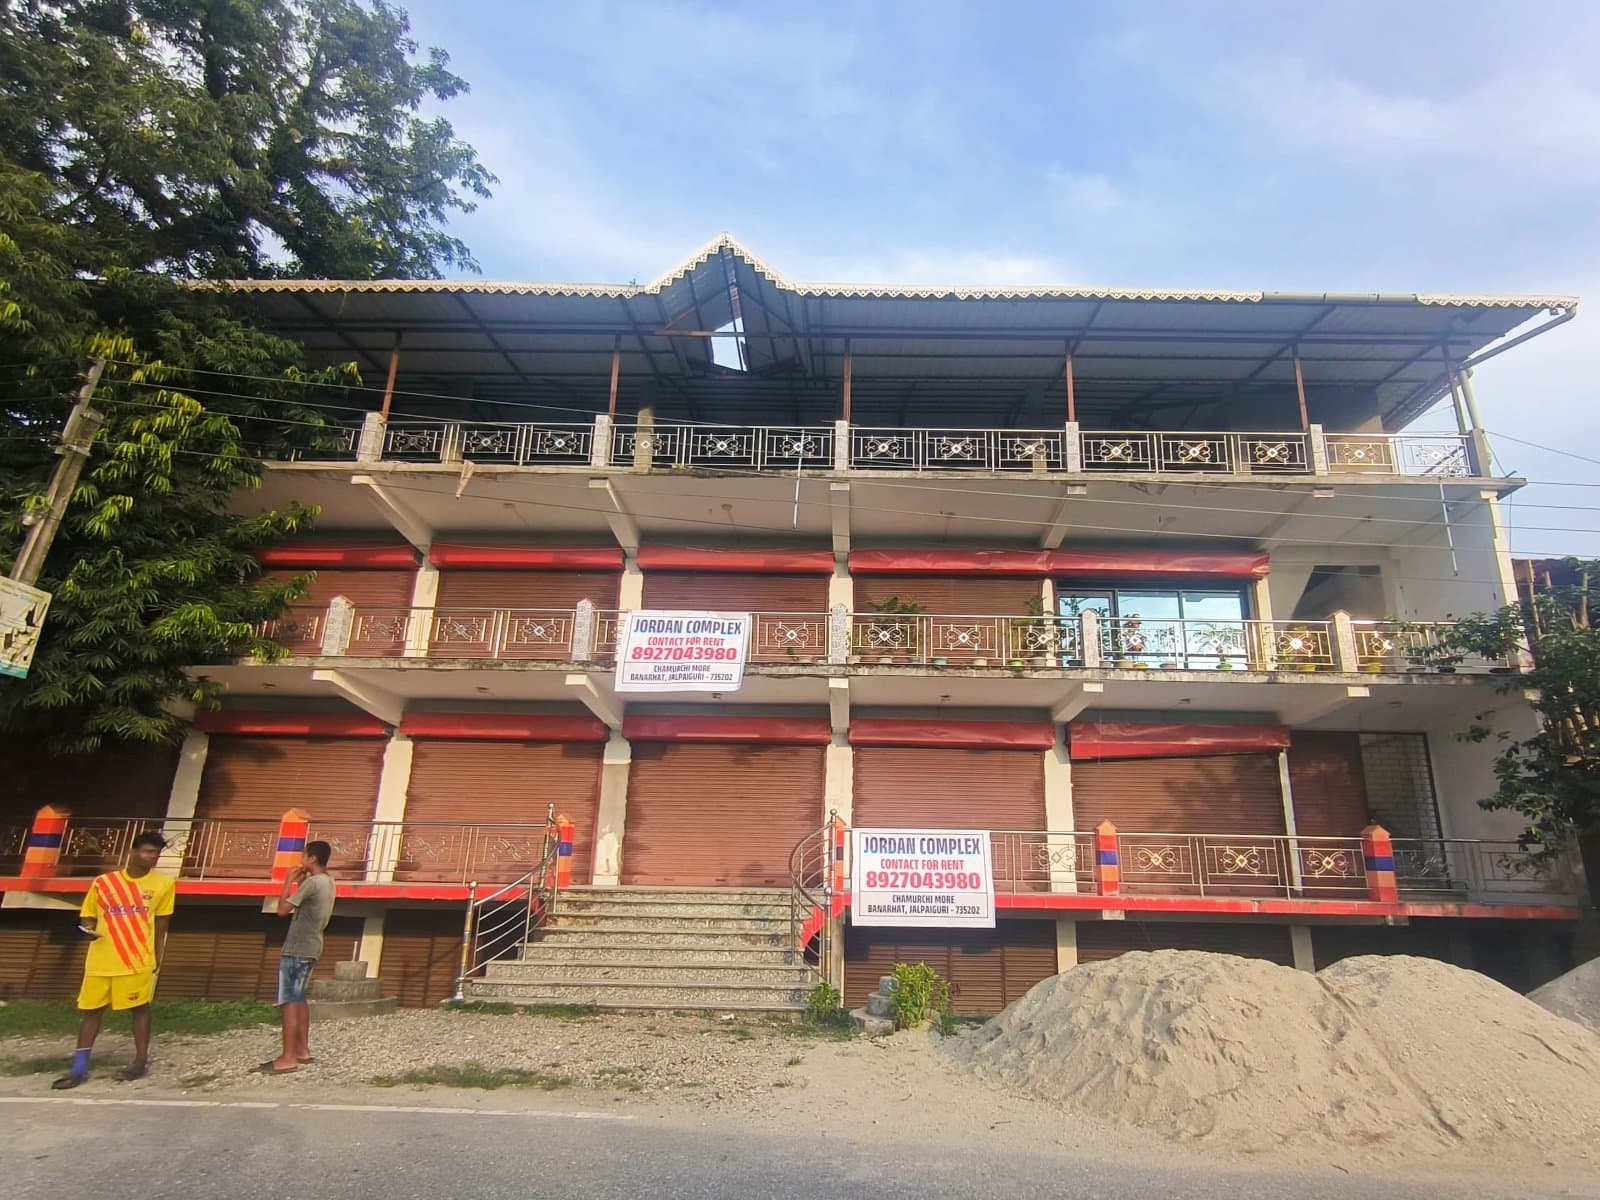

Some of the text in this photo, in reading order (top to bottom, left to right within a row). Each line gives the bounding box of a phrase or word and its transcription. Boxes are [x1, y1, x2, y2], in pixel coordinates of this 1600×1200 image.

[634, 619, 742, 635] JORDAN COMPLEX
[648, 636, 725, 646] CONTACT FOR RENT
[632, 646, 736, 660] 8927043980
[864, 836, 980, 855] JORDAN COMPLEX
[880, 858, 964, 870] CONTACT FOR RENT
[866, 871, 980, 890] 8927043980
[892, 895, 954, 903] CHAMURCHI MORE
[868, 904, 908, 914] BANARHAT,
[909, 906, 948, 914] JALPAIGURI
[956, 906, 980, 914] 735202
